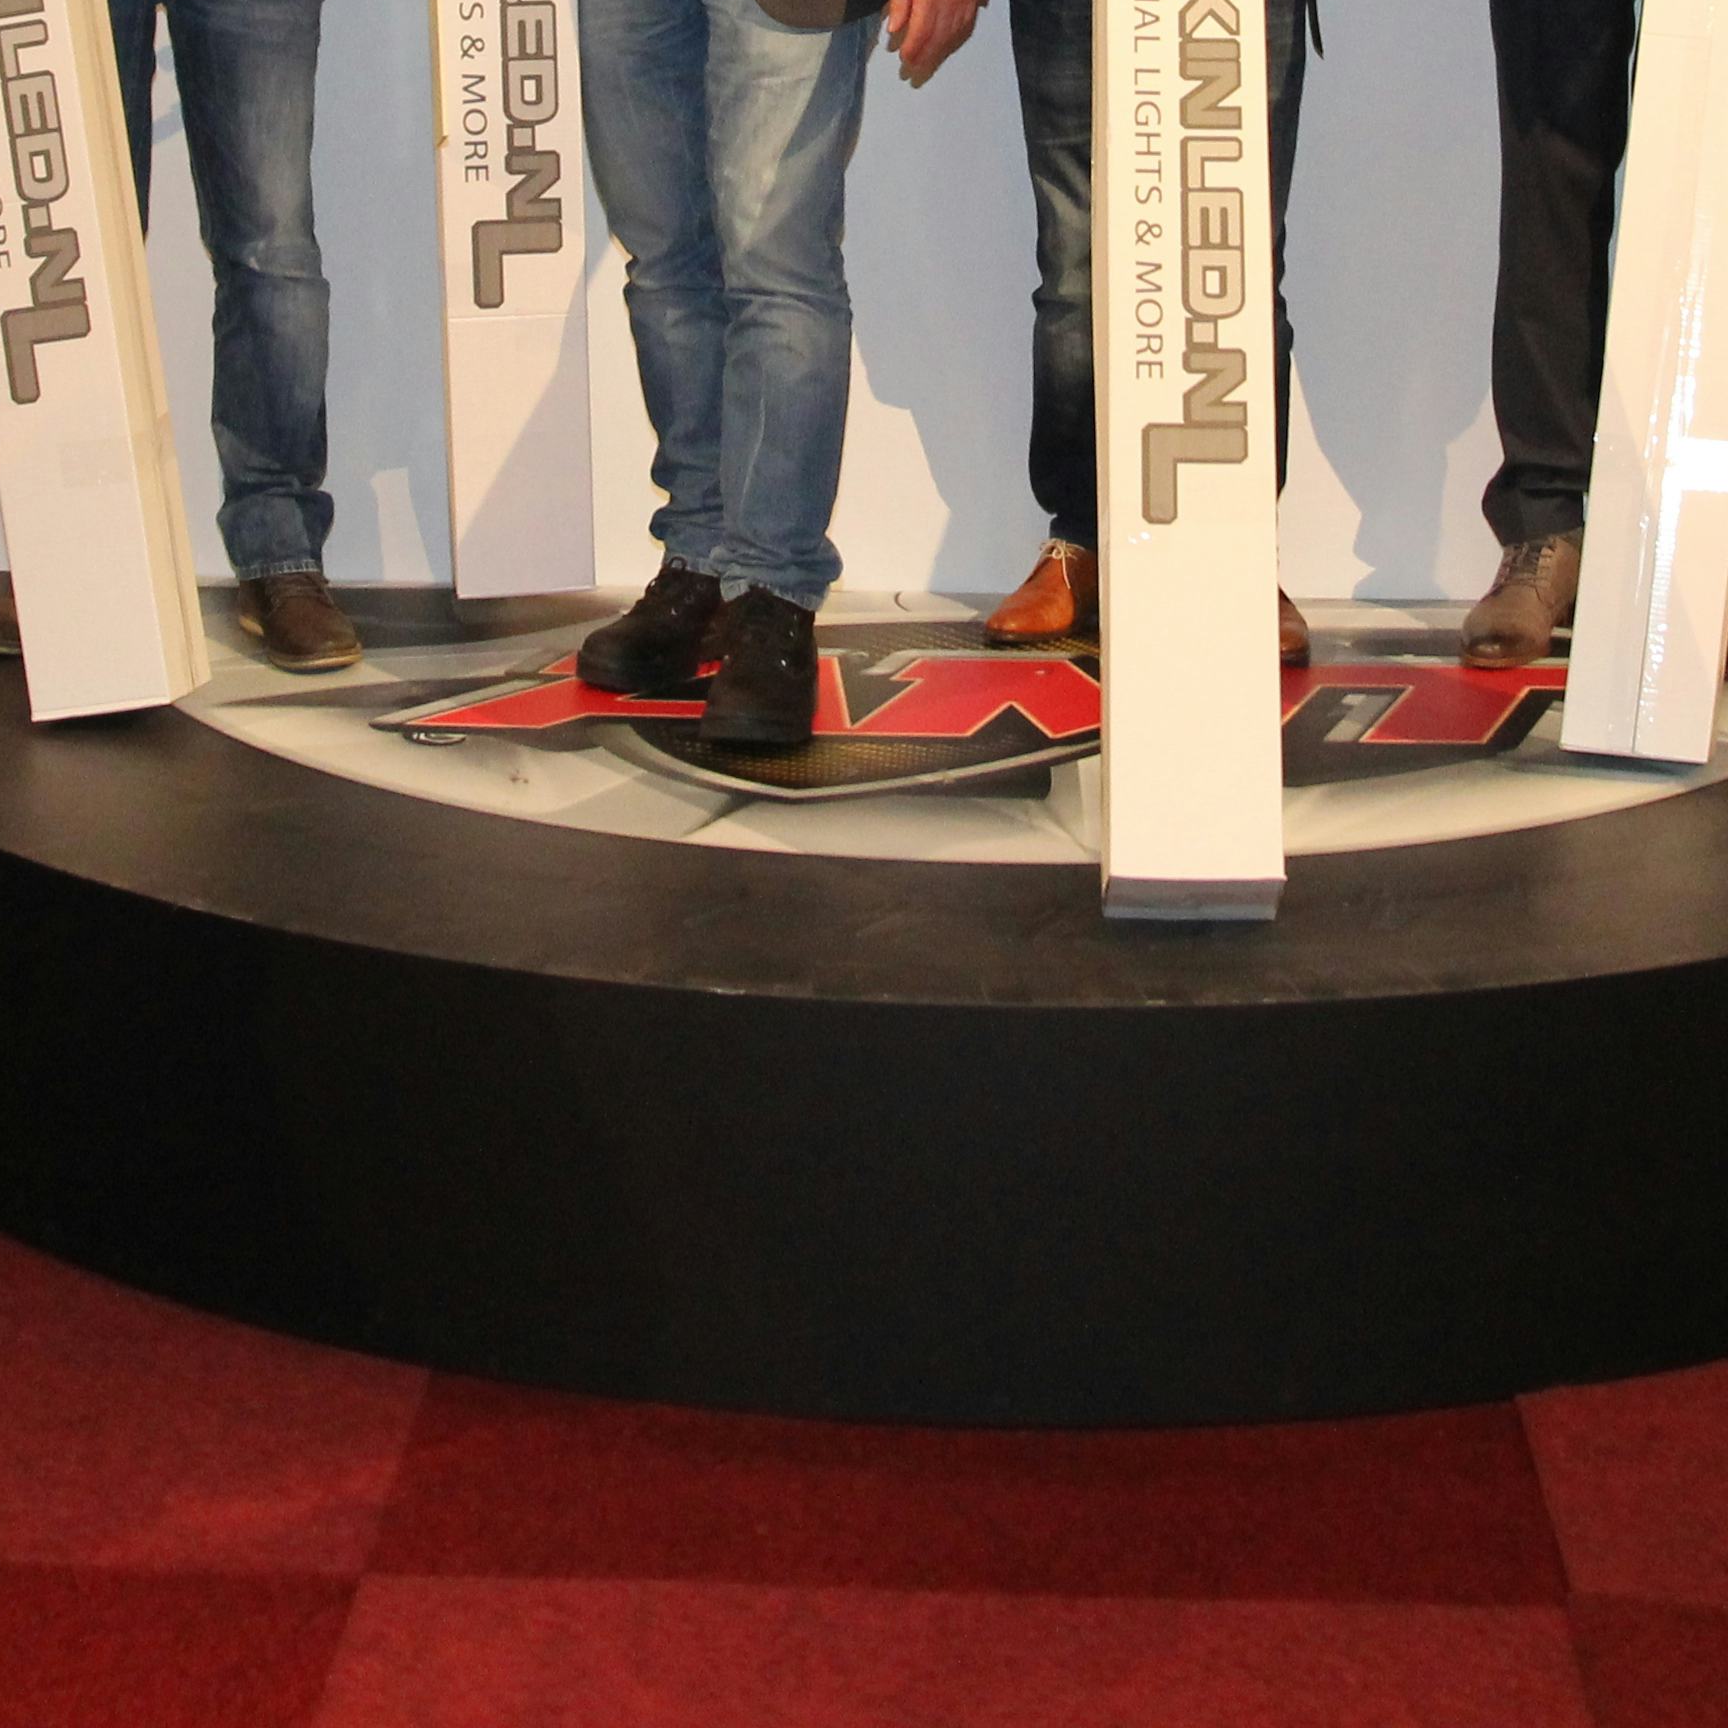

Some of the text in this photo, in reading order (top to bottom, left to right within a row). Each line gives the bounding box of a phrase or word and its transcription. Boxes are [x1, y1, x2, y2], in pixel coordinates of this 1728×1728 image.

[459, 34, 486, 60] &
[461, 72, 490, 183] MORE
[1135, 66, 1163, 205] LIGHTS
[1135, 221, 1163, 246] &
[1135, 261, 1165, 381] MORE
